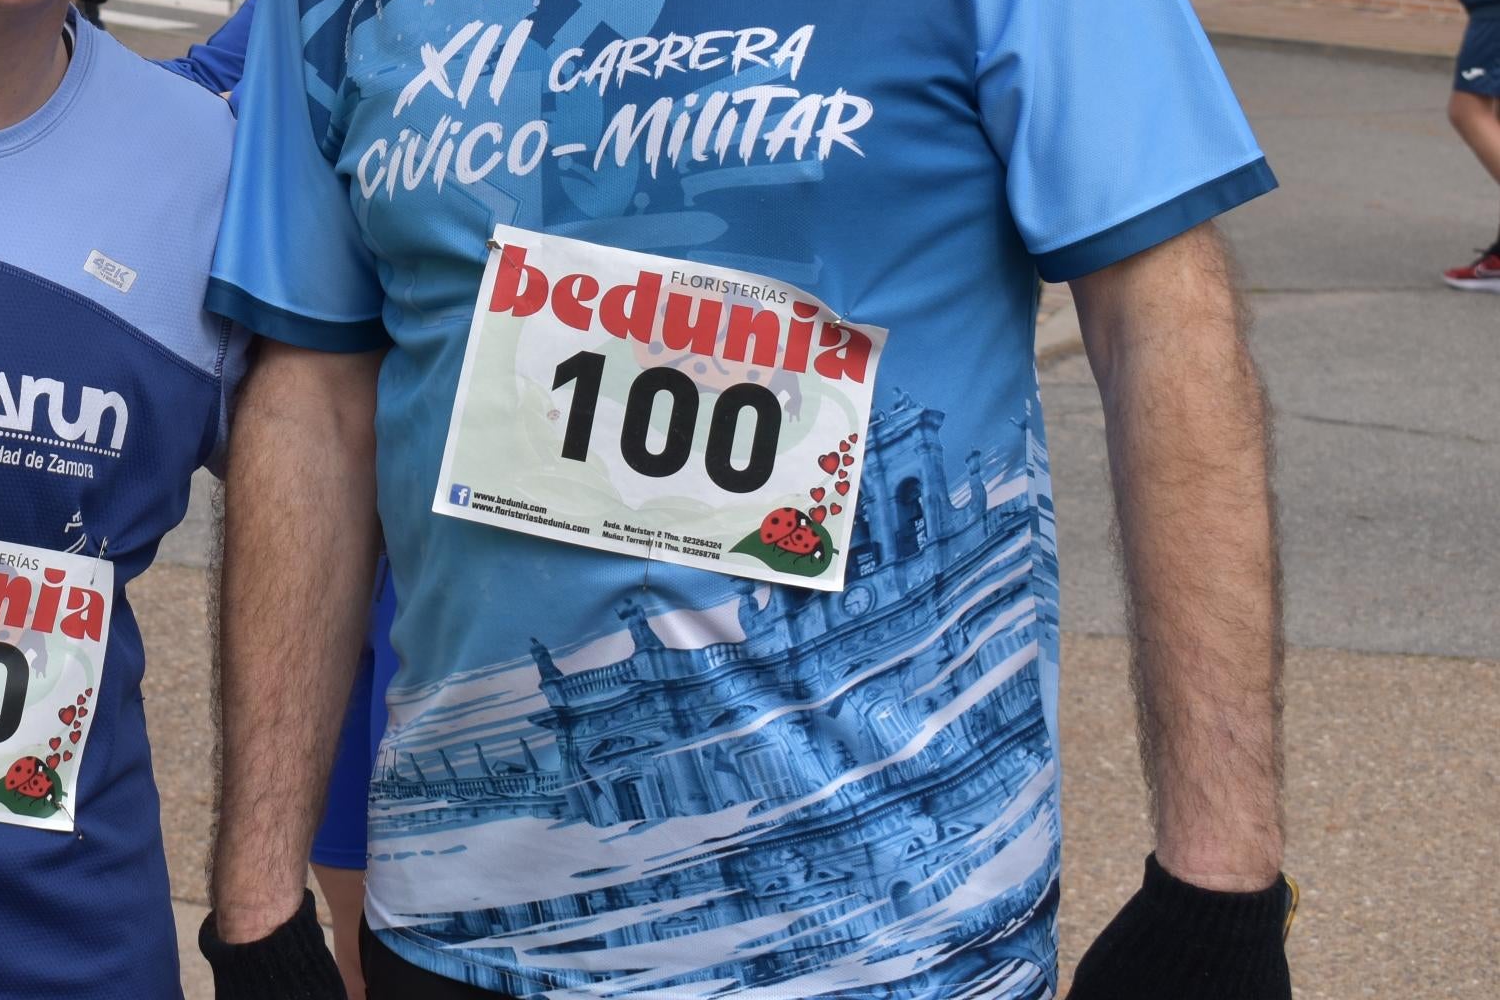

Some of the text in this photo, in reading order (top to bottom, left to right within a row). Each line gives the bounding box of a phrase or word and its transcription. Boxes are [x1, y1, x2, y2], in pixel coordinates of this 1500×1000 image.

[393, 20, 815, 118] XII CARRERA
[670, 271, 787, 304] FLORISTERÍAS
[488, 244, 873, 384] bedunia
[551, 350, 782, 494] 100
[24, 451, 44, 469] de
[47, 453, 94, 478] Zamora
[472, 501, 590, 534] www.floristeriasbedunia.com
[473, 491, 547, 514] www.bedunia.com
[602, 520, 621, 530] Avda.
[657, 530, 662, 538] 2
[664, 532, 680, 542] Tfno.
[602, 530, 624, 542] Muñoz
[626, 536, 654, 547] Torrero
